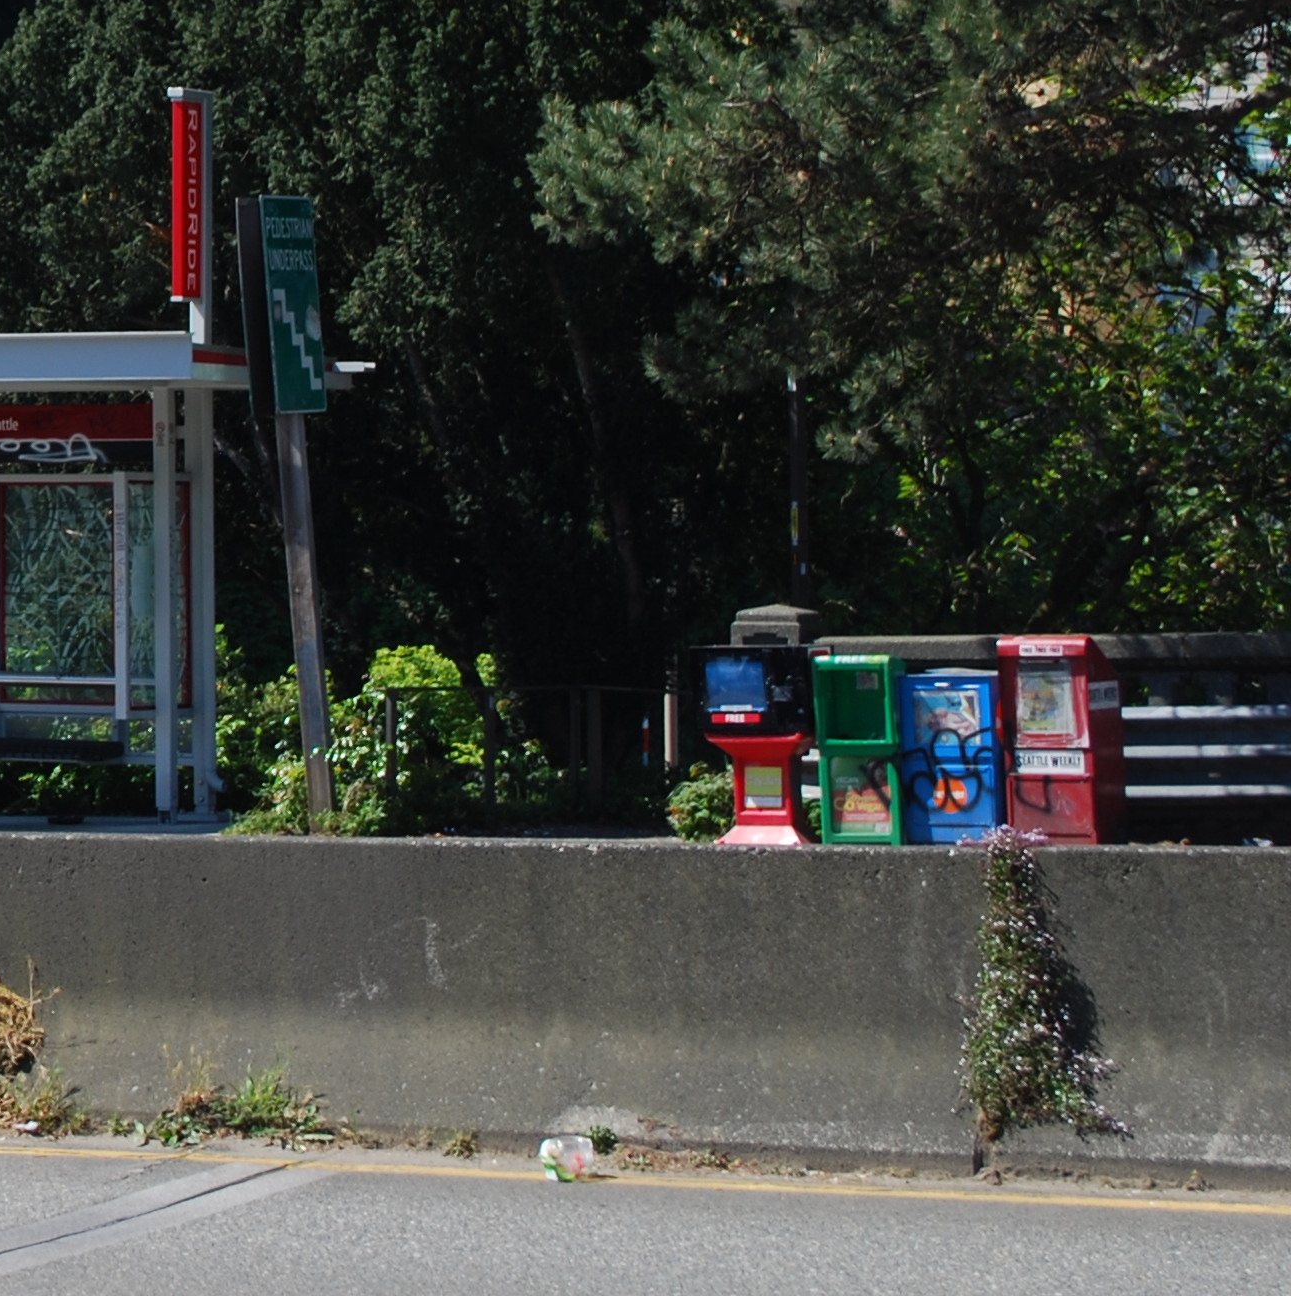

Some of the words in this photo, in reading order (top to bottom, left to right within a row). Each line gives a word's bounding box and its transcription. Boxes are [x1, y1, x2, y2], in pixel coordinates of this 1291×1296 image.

[265, 216, 313, 238] PEDESTRIAN
[268, 249, 314, 271] UNDERPASS
[834, 655, 866, 664] FREE
[725, 714, 745, 723] FREE
[1015, 754, 1048, 768] SEATTLE
[1050, 755, 1081, 767] WEEKLY
